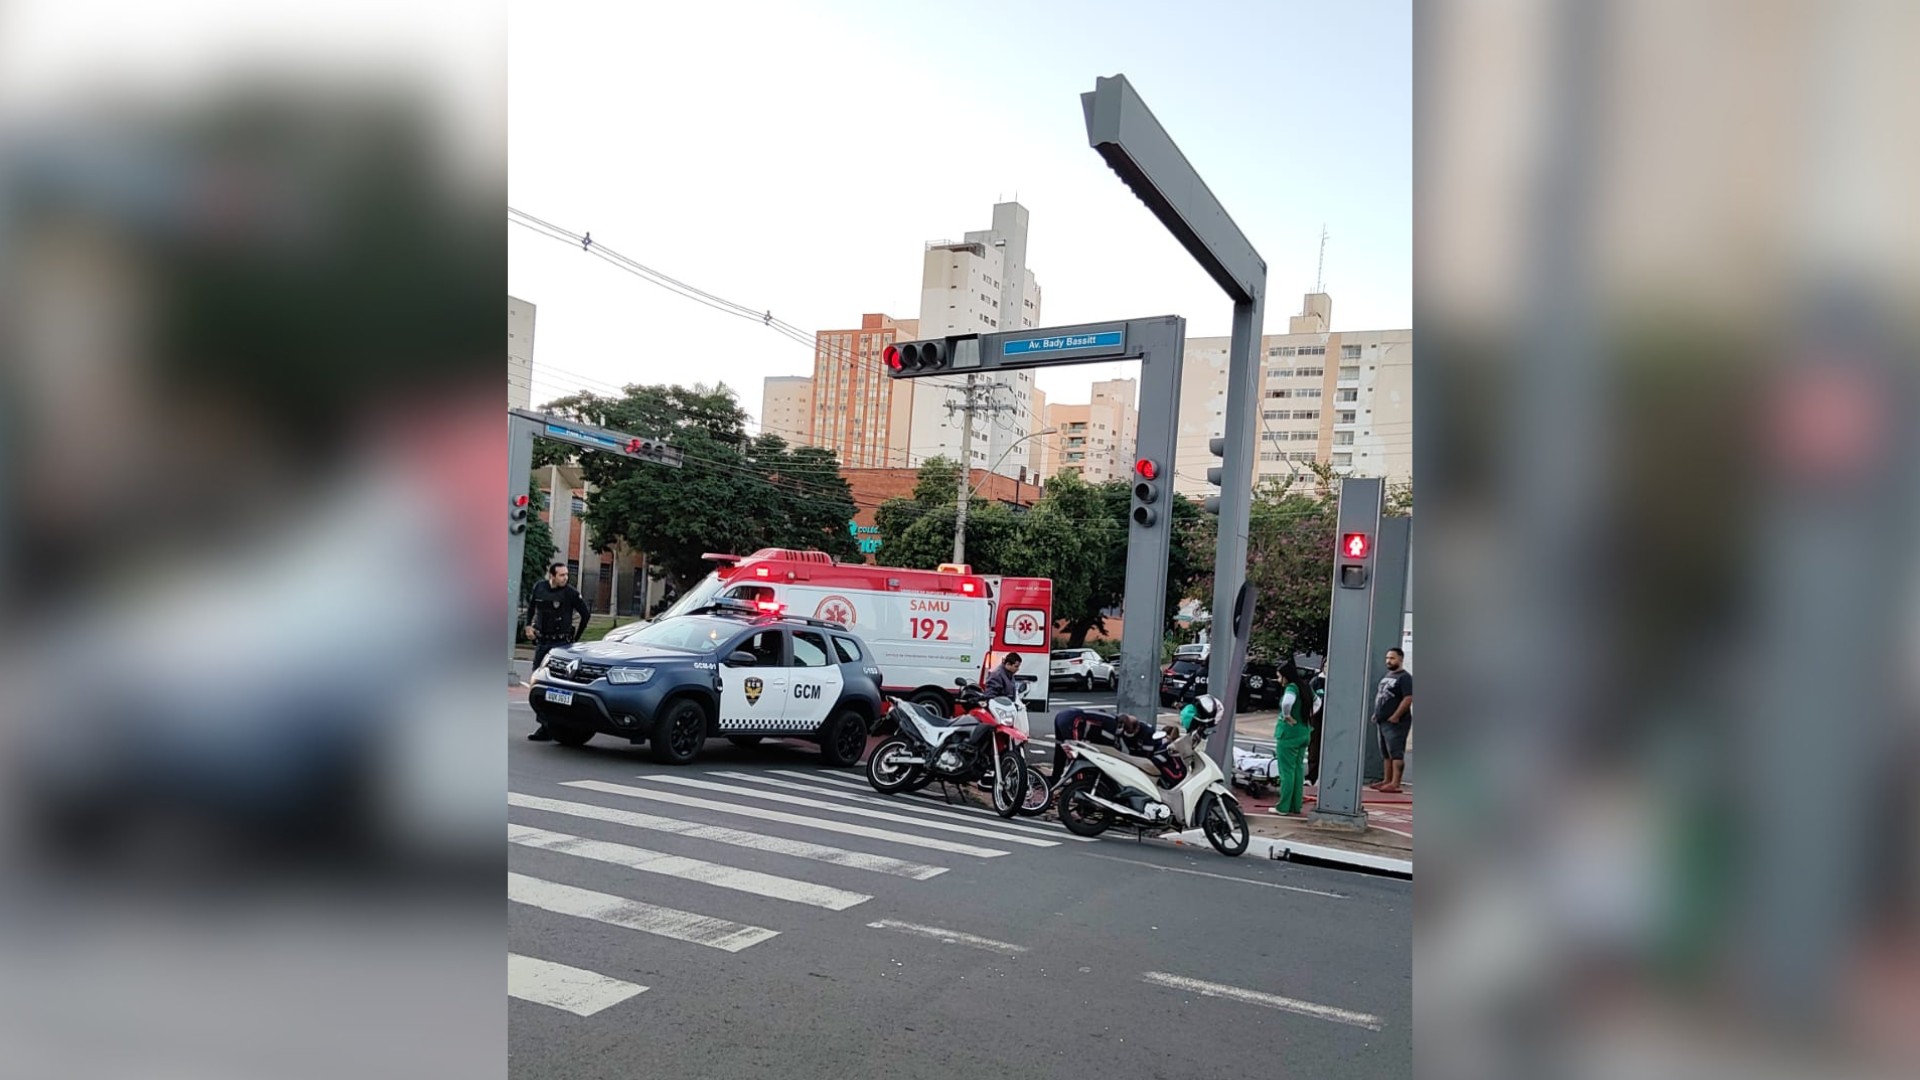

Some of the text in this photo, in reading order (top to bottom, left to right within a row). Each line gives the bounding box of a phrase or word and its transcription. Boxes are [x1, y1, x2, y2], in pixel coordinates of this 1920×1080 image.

[1028, 336, 1096, 349] Av. Bady Bassitt
[910, 600, 950, 612] SAMU
[910, 617, 949, 640] 192
[693, 662, 717, 670] GCM-01
[1195, 676, 1209, 684] GC
[794, 684, 821, 699] GCM
